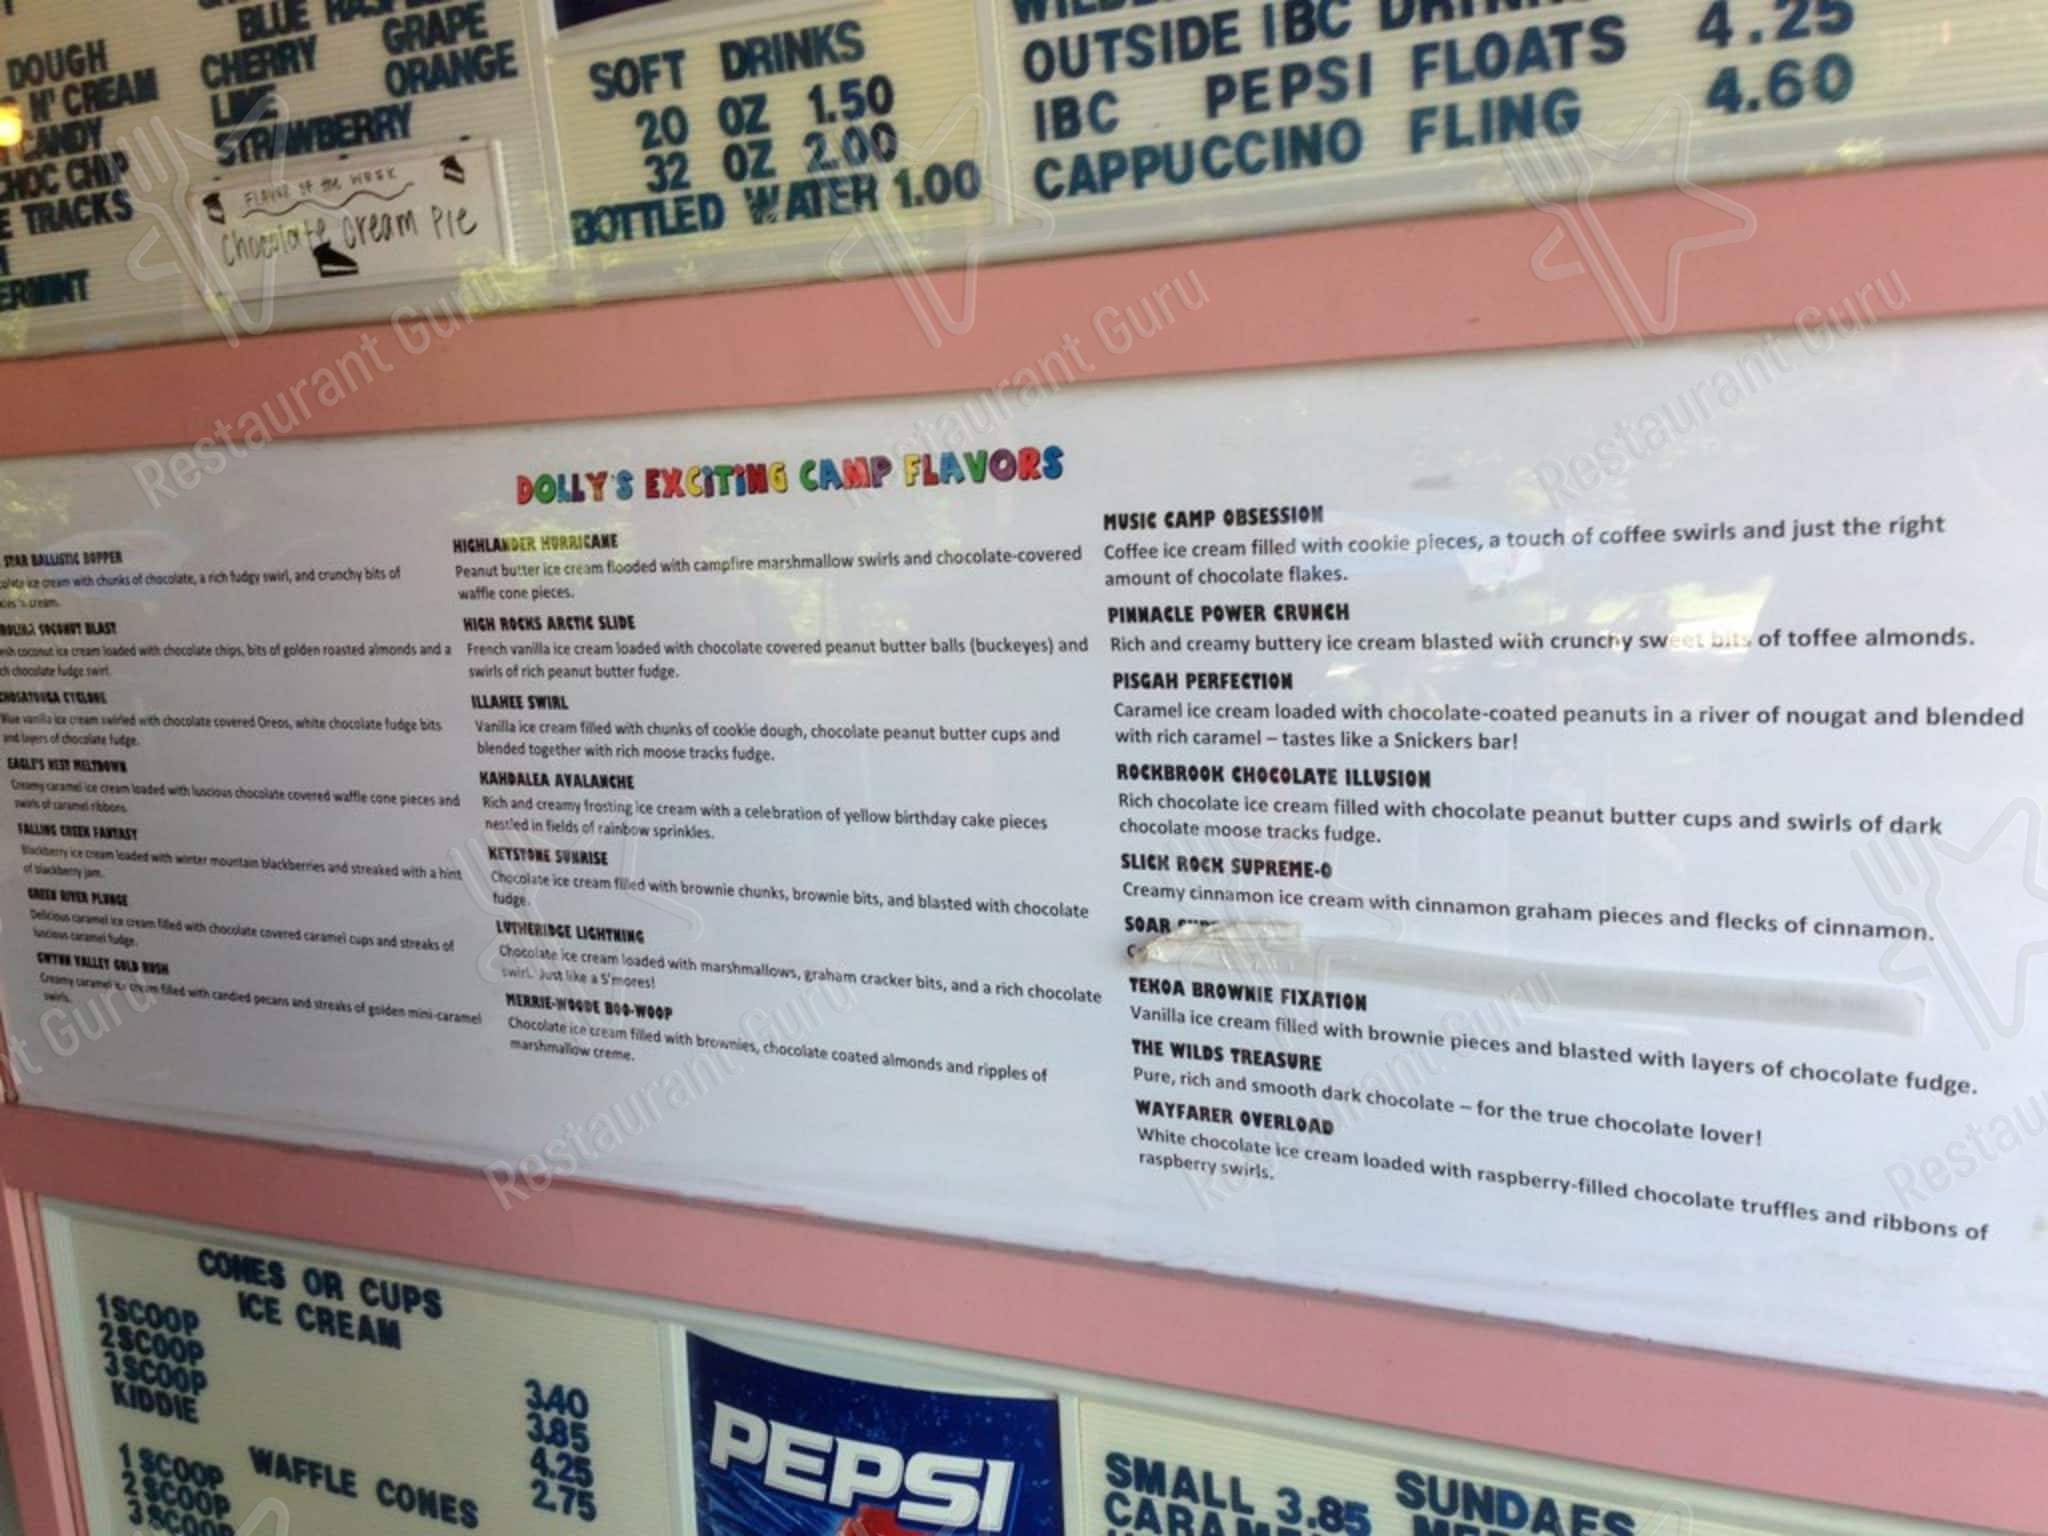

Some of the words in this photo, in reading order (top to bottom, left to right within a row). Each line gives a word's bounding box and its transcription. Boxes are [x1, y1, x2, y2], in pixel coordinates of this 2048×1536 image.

[237, 0, 312, 42] BLUE
[1023, 10, 1241, 83] OUTSIDE
[1262, 0, 1352, 48] IBC
[6, 38, 108, 91] DOUGH
[202, 34, 317, 88] CHERRY
[382, 1, 489, 55] GRAPE
[588, 50, 686, 102] SOFT
[719, 20, 865, 80] DRINKS
[385, 40, 518, 97] ORANGE
[1035, 90, 1119, 142] IBC
[1206, 52, 1372, 118] PEPSI
[1412, 14, 1628, 90] FLOATS
[1697, 0, 1855, 49] 4.25
[61, 66, 160, 117] CREAM
[215, 102, 412, 165] STRAWBERRY
[635, 106, 689, 151] 20
[717, 93, 771, 137] OZ
[807, 75, 894, 123] 1.50
[1034, 117, 1363, 200] CAPPUCCINO
[1410, 87, 1582, 153] FLING
[1706, 52, 1855, 115] 4.60
[66, 151, 130, 191] CHIP
[644, 152, 690, 194] 32
[722, 139, 775, 182] OZ
[805, 122, 897, 171] 2.00
[22, 188, 133, 236] TRACKS
[571, 198, 725, 246] BOTTLED
[743, 179, 879, 226] WATER
[894, 158, 981, 207] 1.00
[516, 470, 634, 505] DOLLY'S
[799, 456, 893, 493] CAMP
[905, 445, 1064, 488] FLAVORS
[1104, 512, 1156, 530] MUSIC
[1164, 510, 1215, 528] CAMP
[1223, 505, 1323, 526] OBSESSION
[453, 537, 536, 553] HIGHLANDER
[541, 533, 618, 550] HURRICANE
[458, 586, 495, 600] waffle
[499, 590, 528, 600] cone
[532, 587, 574, 601] pieces.
[1105, 571, 1170, 586] amount
[1176, 569, 1193, 584] of
[1198, 568, 1283, 585] chocolate
[1289, 565, 1348, 582] flakes.
[463, 617, 495, 632] HIGH
[500, 616, 542, 630] ROCKS
[548, 615, 594, 631] ARCTIC
[598, 615, 635, 630] SLIDE
[1108, 606, 1194, 624] PINNACLE
[1201, 604, 1266, 622] POWER
[1273, 603, 1349, 621] CRUNCH
[471, 694, 523, 709] ILLAHEE
[528, 695, 568, 710] SWIRL
[1113, 672, 1178, 689] PISGAH
[1186, 672, 1293, 690] PERFECTION
[4, 733, 20, 743] and
[51, 733, 59, 744] of
[62, 733, 106, 745] chocolate
[109, 734, 138, 749] fudge.
[555, 773, 634, 789] AVALANCHE
[1117, 764, 1224, 782] ROCKBROOK
[1232, 766, 1337, 785] CHOCOLATE
[1345, 768, 1430, 788] ILLUSION
[1120, 818, 1199, 836] chocolate
[1205, 825, 1261, 839] moose
[1267, 824, 1319, 840] tracks
[1325, 825, 1380, 846] fudge.
[488, 847, 550, 863] KEYSTONE
[556, 850, 608, 866] SUNRISE
[1121, 853, 1169, 870] SLICK
[1177, 856, 1224, 873] ROCK
[496, 920, 572, 938] LUTHERIDGE
[576, 926, 644, 943] LIGHTNING
[1123, 882, 1184, 901] Creamy
[1190, 887, 1274, 903] cinnamon
[1280, 890, 1303, 905] ice
[1309, 894, 1363, 908] cream
[1369, 895, 1410, 910] with
[1416, 897, 1510, 916] cinnamon
[1516, 903, 1592, 921] graham
[1599, 907, 1663, 925] pieces
[1670, 911, 1709, 928] and
[1716, 912, 1777, 932] flecks
[1785, 916, 1806, 933] of
[1814, 918, 1933, 940] cinnamon.
[1125, 916, 1171, 934] SOAR
[1129, 977, 1185, 996] TEKOA
[1192, 982, 1273, 1003] BROWNIE
[1281, 988, 1366, 1011] FIXATION
[510, 1040, 590, 1056] marshmallow
[593, 1048, 634, 1061] creme.
[1132, 1039, 1163, 1056] THE
[1170, 1042, 1224, 1062] WILDS
[1230, 1047, 1322, 1071] TREASURE
[1136, 1099, 1232, 1124] WAYFARER
[1240, 1111, 1333, 1135] OVERLOAD
[1140, 1153, 1216, 1175] raspberry
[1222, 1163, 1273, 1180] swirls.
[302, 1267, 345, 1300] OR
[359, 1276, 444, 1320] CUPS
[236, 1290, 282, 1326] ICE
[295, 1302, 402, 1350] CREAM
[111, 1381, 200, 1424] KIDDIE
[524, 1380, 589, 1419] 3.40
[526, 1413, 590, 1452] 3.85
[138, 1448, 224, 1490] SCOOP
[249, 1446, 358, 1498] WAFFLE
[530, 1447, 594, 1487] 4.25
[709, 1400, 1015, 1532] PEPSI
[142, 1477, 231, 1519] SCOOP
[532, 1480, 597, 1522] 2.75
[1105, 1452, 1254, 1515] SMALL
[1276, 1487, 1371, 1536] 3.85
[1396, 1470, 1636, 1536] SUNDAES
